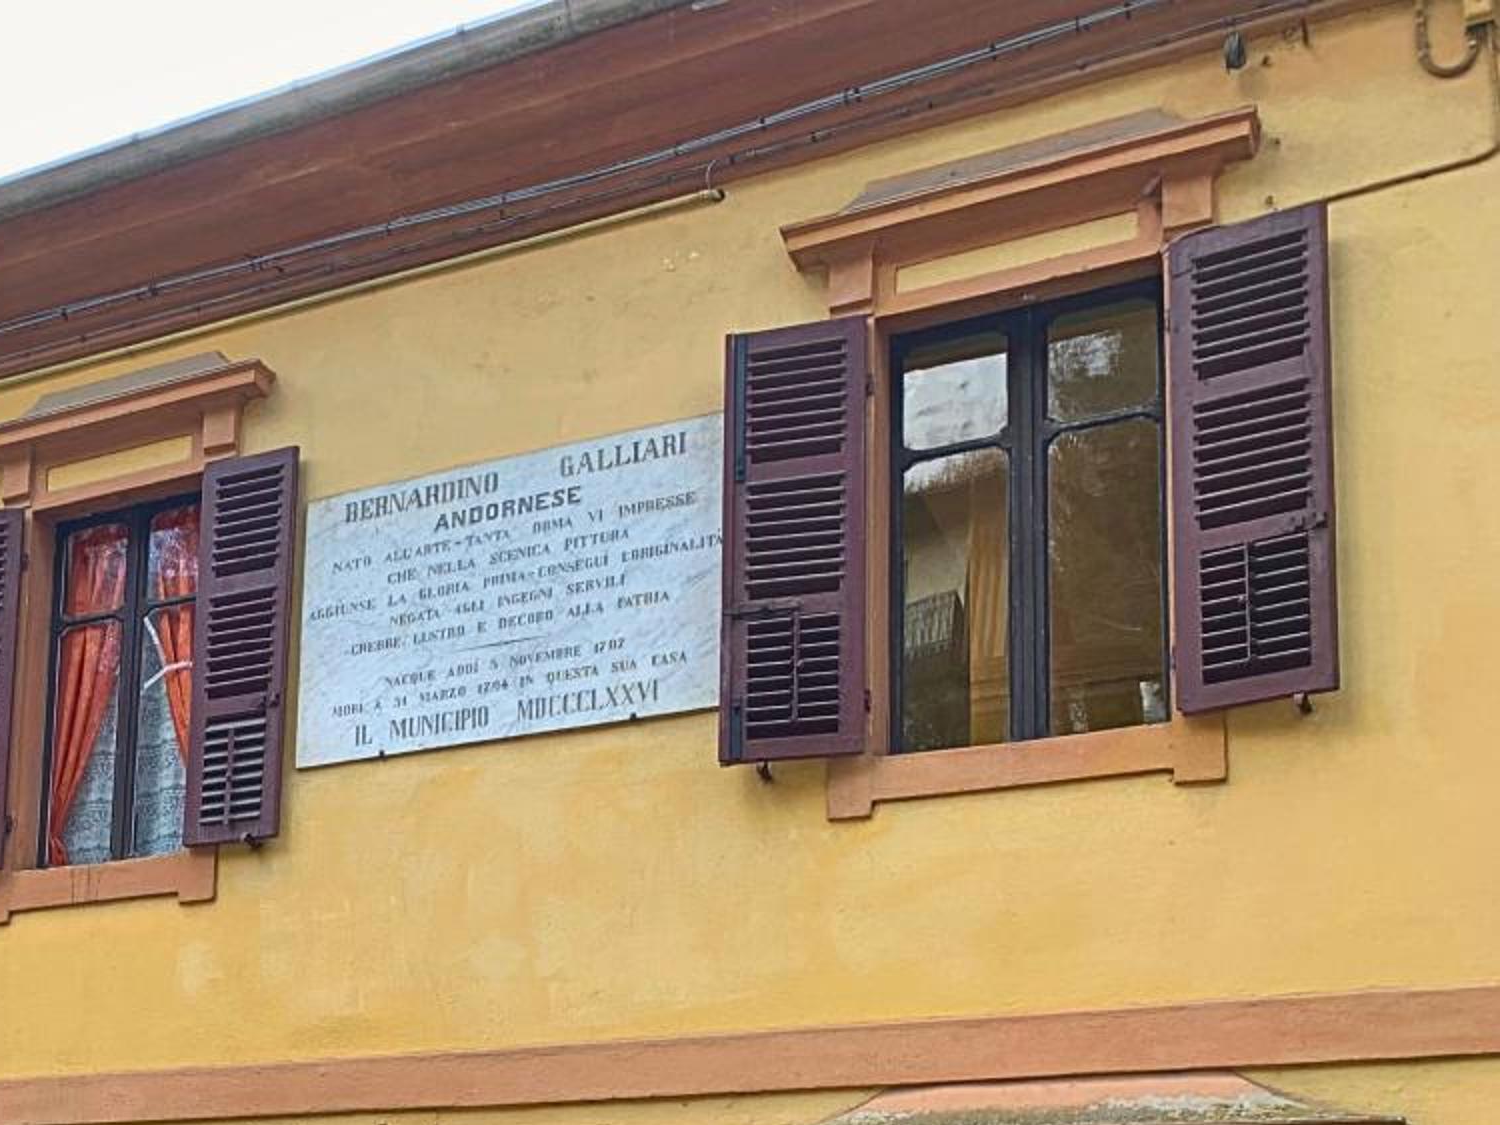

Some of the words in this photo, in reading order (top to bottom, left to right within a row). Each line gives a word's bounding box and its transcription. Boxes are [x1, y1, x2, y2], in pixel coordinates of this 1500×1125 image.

[345, 472, 499, 523] BERNARDINO
[560, 432, 687, 477] GALLIARI
[332, 555, 371, 574] NATO
[533, 516, 573, 534] ORMA
[618, 491, 697, 517] IMPRESSE
[434, 486, 581, 532] ANDORNESE
[387, 568, 418, 585] CHE
[427, 559, 476, 578] NELLA
[489, 543, 550, 566] SCENICA
[564, 529, 629, 552] PITTURA
[388, 593, 407, 608] LA
[419, 581, 469, 600] GLORIA
[390, 608, 440, 626] NEGATA
[498, 587, 553, 608] INGEGNI
[566, 573, 625, 595] SERVILI
[413, 625, 465, 645] LUSTRO
[498, 609, 553, 629] DECORO
[567, 602, 604, 618] ALLA
[617, 590, 670, 609] PATRIA
[419, 685, 466, 703] MARZO
[547, 663, 599, 684] QUESTA
[611, 658, 637, 673] SUA
[651, 650, 687, 667] CASA
[510, 645, 581, 668] NOVEMBRE
[355, 724, 373, 746] IL
[389, 706, 490, 739] MUNICIPIO
[517, 679, 659, 721] MDCCCLXXVI
